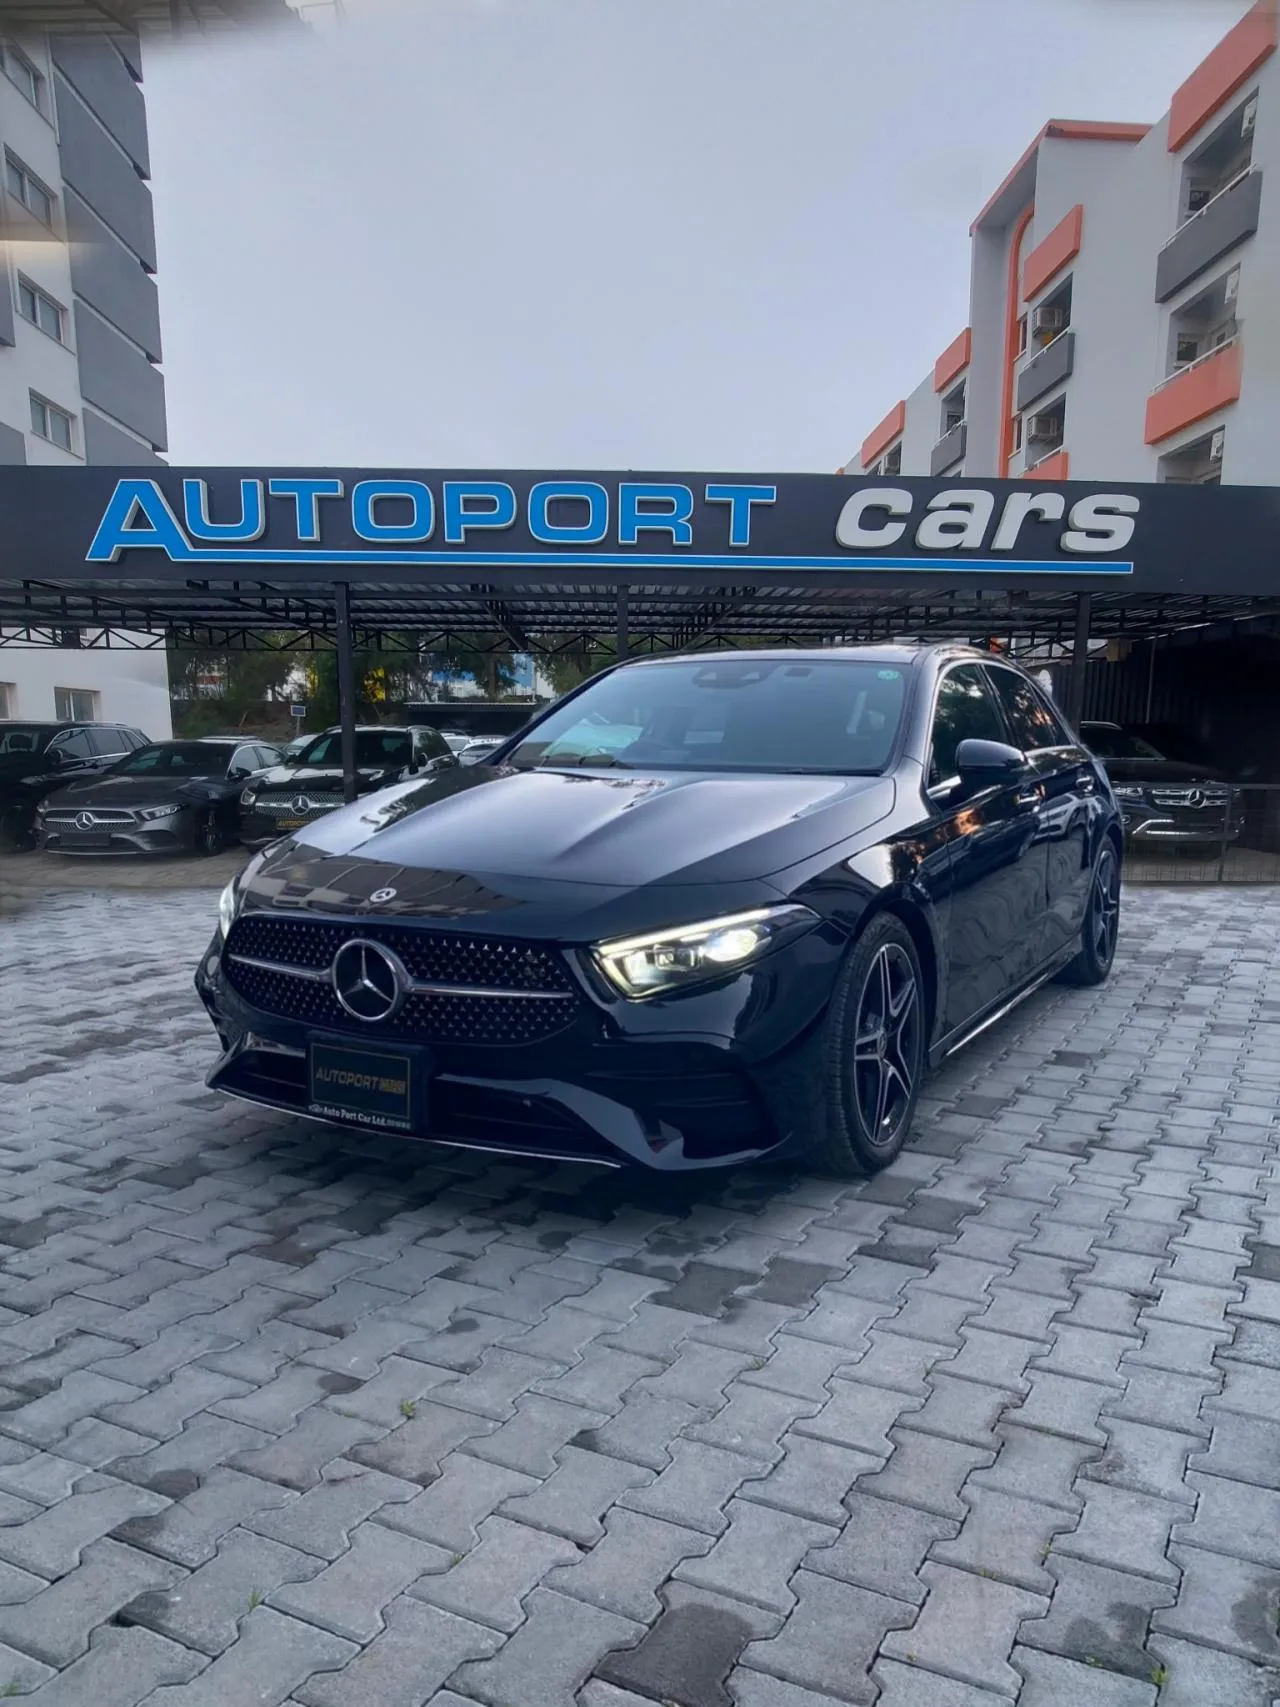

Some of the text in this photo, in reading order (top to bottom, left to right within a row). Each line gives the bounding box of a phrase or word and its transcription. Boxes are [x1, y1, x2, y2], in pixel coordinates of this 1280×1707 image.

[85, 477, 1142, 561] AUTOPORT cars
[316, 1067, 379, 1090] AUTOPORT
[323, 1106, 340, 1117] Auto
[341, 1108, 357, 1121] Port
[358, 1112, 371, 1123] Car
